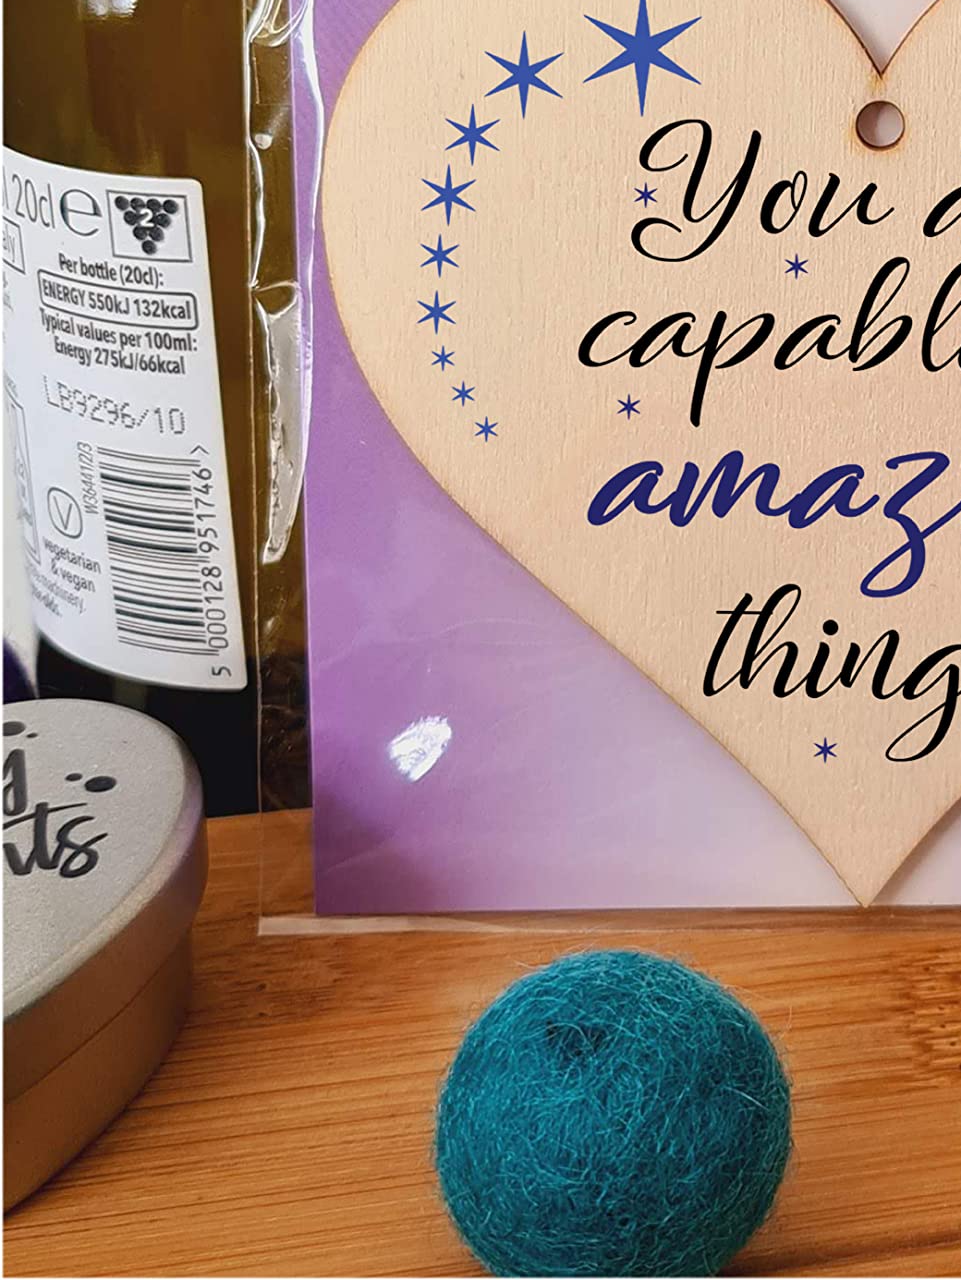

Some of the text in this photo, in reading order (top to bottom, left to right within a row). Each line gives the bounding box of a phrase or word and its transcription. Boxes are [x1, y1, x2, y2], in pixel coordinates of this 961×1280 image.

[11, 173, 56, 229] 20cl
[630, 118, 895, 263] You
[58, 252, 164, 289] Per bottle (20cl):
[43, 278, 86, 308] ENERGY
[88, 291, 131, 316] 550kJ
[134, 298, 192, 320] 132kcal
[39, 307, 198, 352] Typical values per 100ml:
[54, 335, 186, 375] Energy 275kJ/66kcal
[42, 535, 102, 575] vegetarian
[60, 567, 96, 592] vegan
